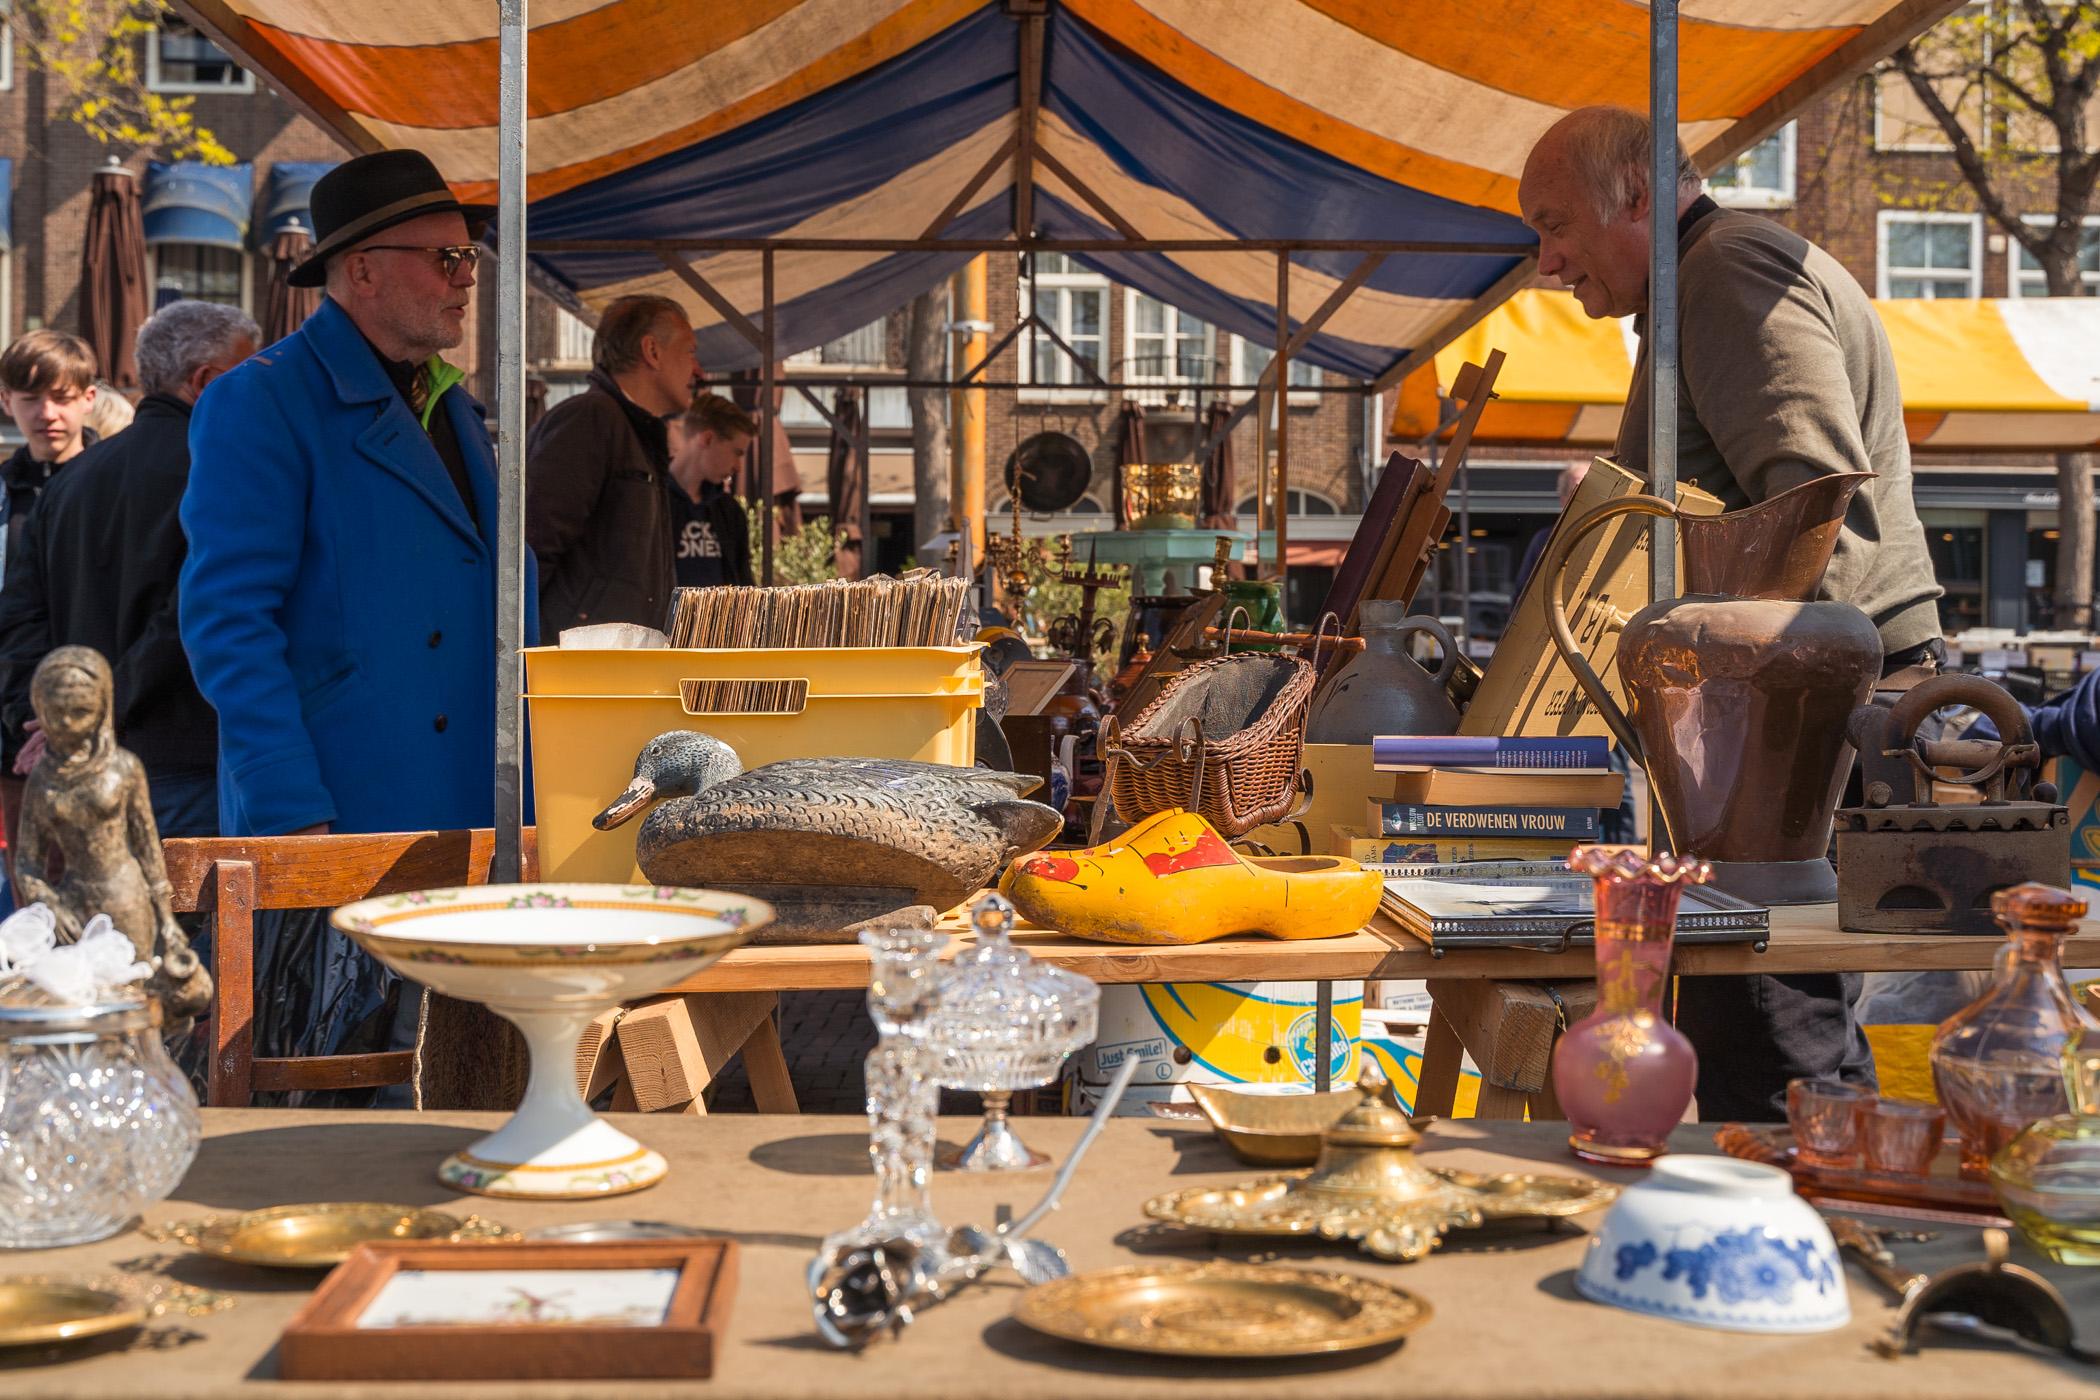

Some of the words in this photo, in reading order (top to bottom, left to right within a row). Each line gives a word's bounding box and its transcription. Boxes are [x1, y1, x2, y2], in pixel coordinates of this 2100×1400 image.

[1426, 812, 1442, 828] DE
[1444, 812, 1518, 829] VERDWENEN
[1520, 814, 1566, 831] VROUW
[1101, 1049, 1125, 1066] Just
